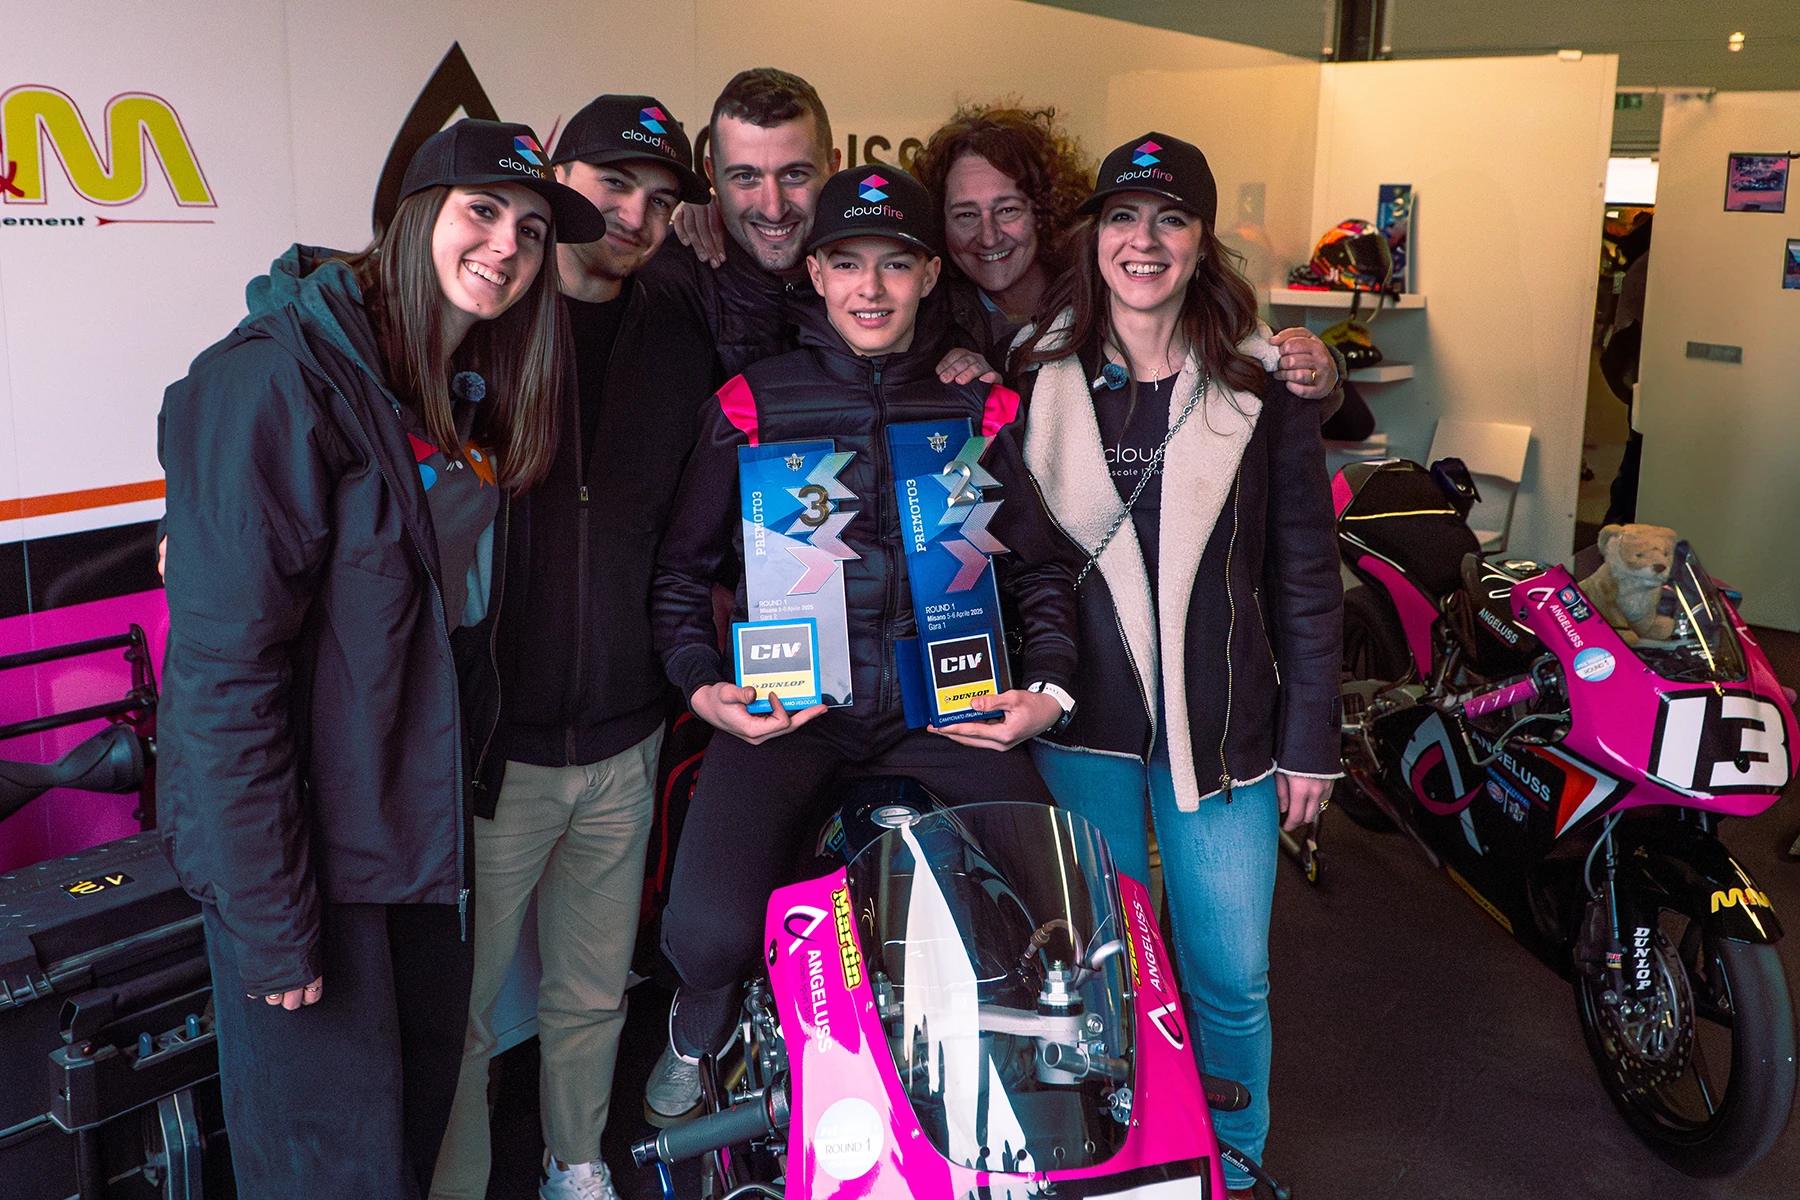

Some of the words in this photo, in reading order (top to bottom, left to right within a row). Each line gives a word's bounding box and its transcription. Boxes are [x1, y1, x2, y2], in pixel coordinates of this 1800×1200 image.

[1115, 168, 1173, 184] cloudfire
[0, 216, 85, 227] ement
[843, 204, 904, 220] cloudfire
[1104, 443, 1165, 463] clou
[943, 460, 975, 507] 2
[798, 484, 830, 527] 3
[906, 478, 927, 552] PREMOTO3
[751, 491, 766, 556] PREMOTO3
[758, 600, 782, 608] ROUND
[925, 604, 950, 614] ROUND
[927, 614, 947, 623] Misano
[970, 607, 984, 616] 2025
[928, 623, 942, 631] Gara
[1477, 607, 1519, 645] ANGELUSS
[1550, 604, 1584, 649] ANGELUSS
[760, 680, 805, 689] DUNLOP
[952, 689, 990, 701] DUNLOP
[1656, 695, 1789, 789] 13
[1471, 731, 1551, 802] ANELUSS
[1133, 900, 1162, 992] ANGELUSS
[1633, 927, 1652, 991] DUNLOP
[807, 949, 833, 1053] ANGELUSS
[825, 1142, 862, 1155] ROUND
[866, 1137, 871, 1152] 1
[1220, 1149, 1250, 1173] domino
